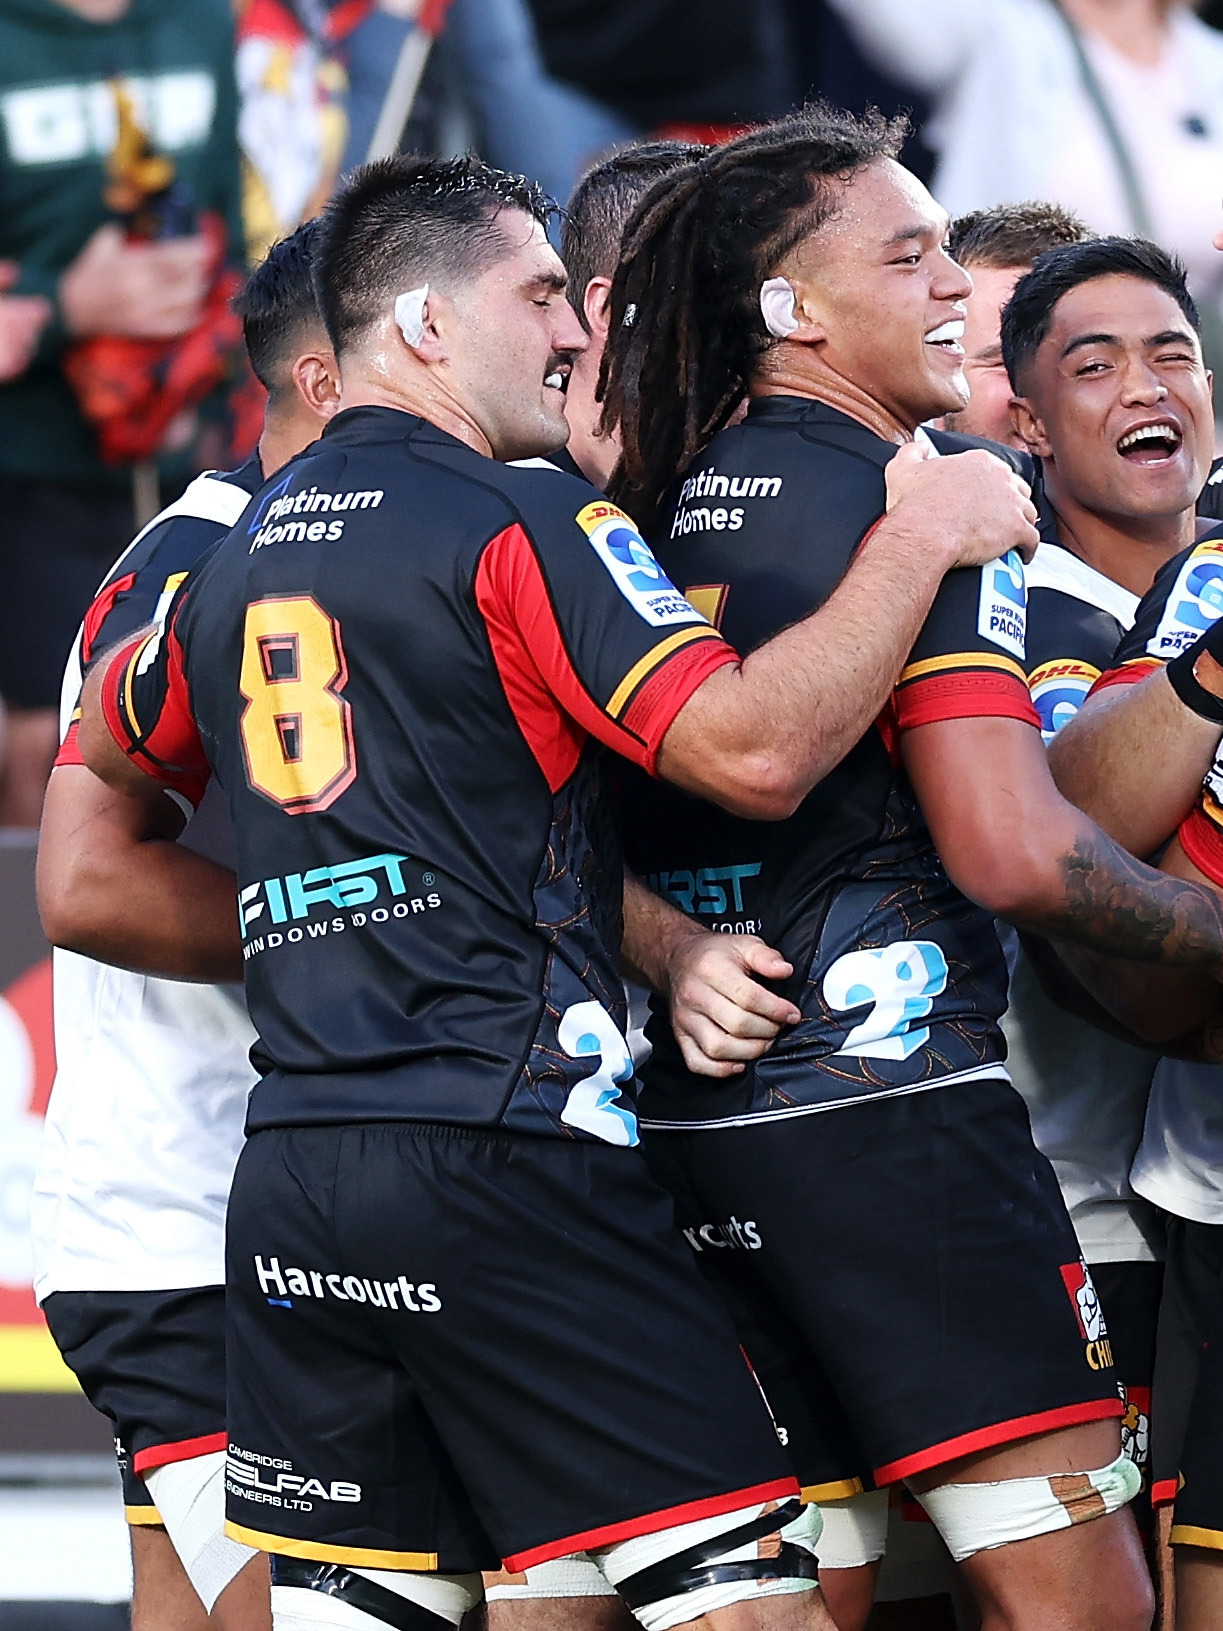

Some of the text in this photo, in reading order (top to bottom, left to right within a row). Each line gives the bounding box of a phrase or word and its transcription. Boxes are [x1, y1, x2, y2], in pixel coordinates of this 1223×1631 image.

[262, 486, 384, 527] Platinum
[670, 507, 744, 539] Homes
[249, 519, 345, 555] Homes
[239, 592, 357, 816] 8
[254, 1255, 442, 1312] Harcourts
[284, 1498, 313, 1512] LTD
